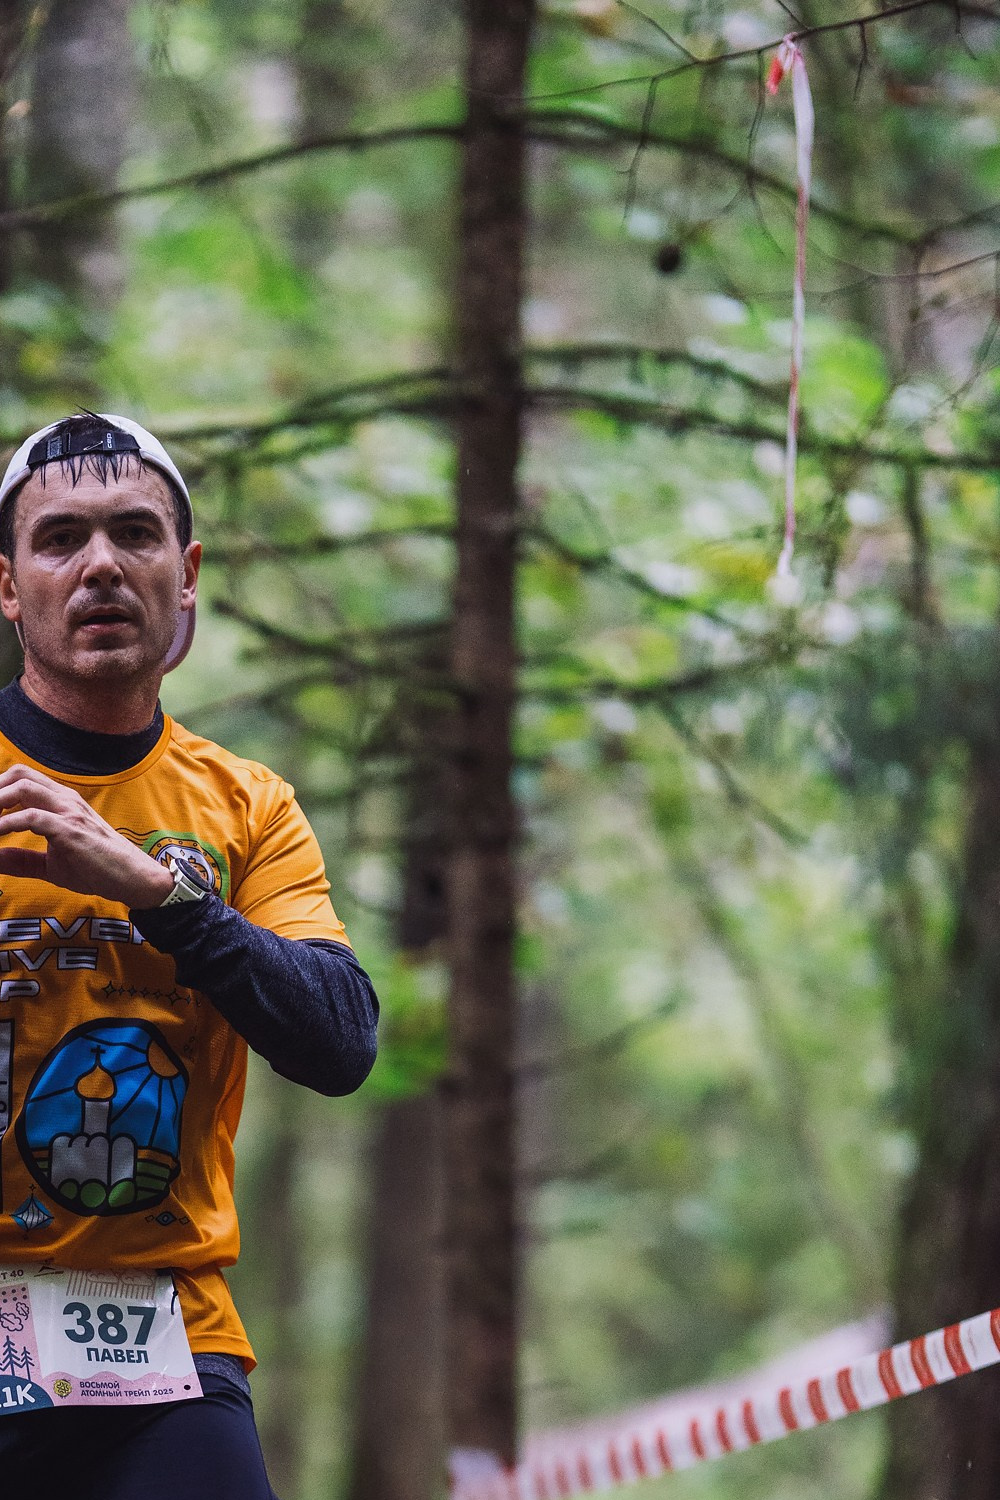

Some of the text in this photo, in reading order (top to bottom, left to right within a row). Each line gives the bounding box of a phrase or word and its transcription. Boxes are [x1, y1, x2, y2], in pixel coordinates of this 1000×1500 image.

[10, 1269, 25, 1279] 40
[62, 1301, 158, 1346] 387
[86, 1347, 150, 1364] ПАВЕЛ
[79, 1381, 120, 1389] ВОСЬМОЙ
[80, 1388, 174, 1397] АТОМНЫЙ ТРЕЙЛ 2025
